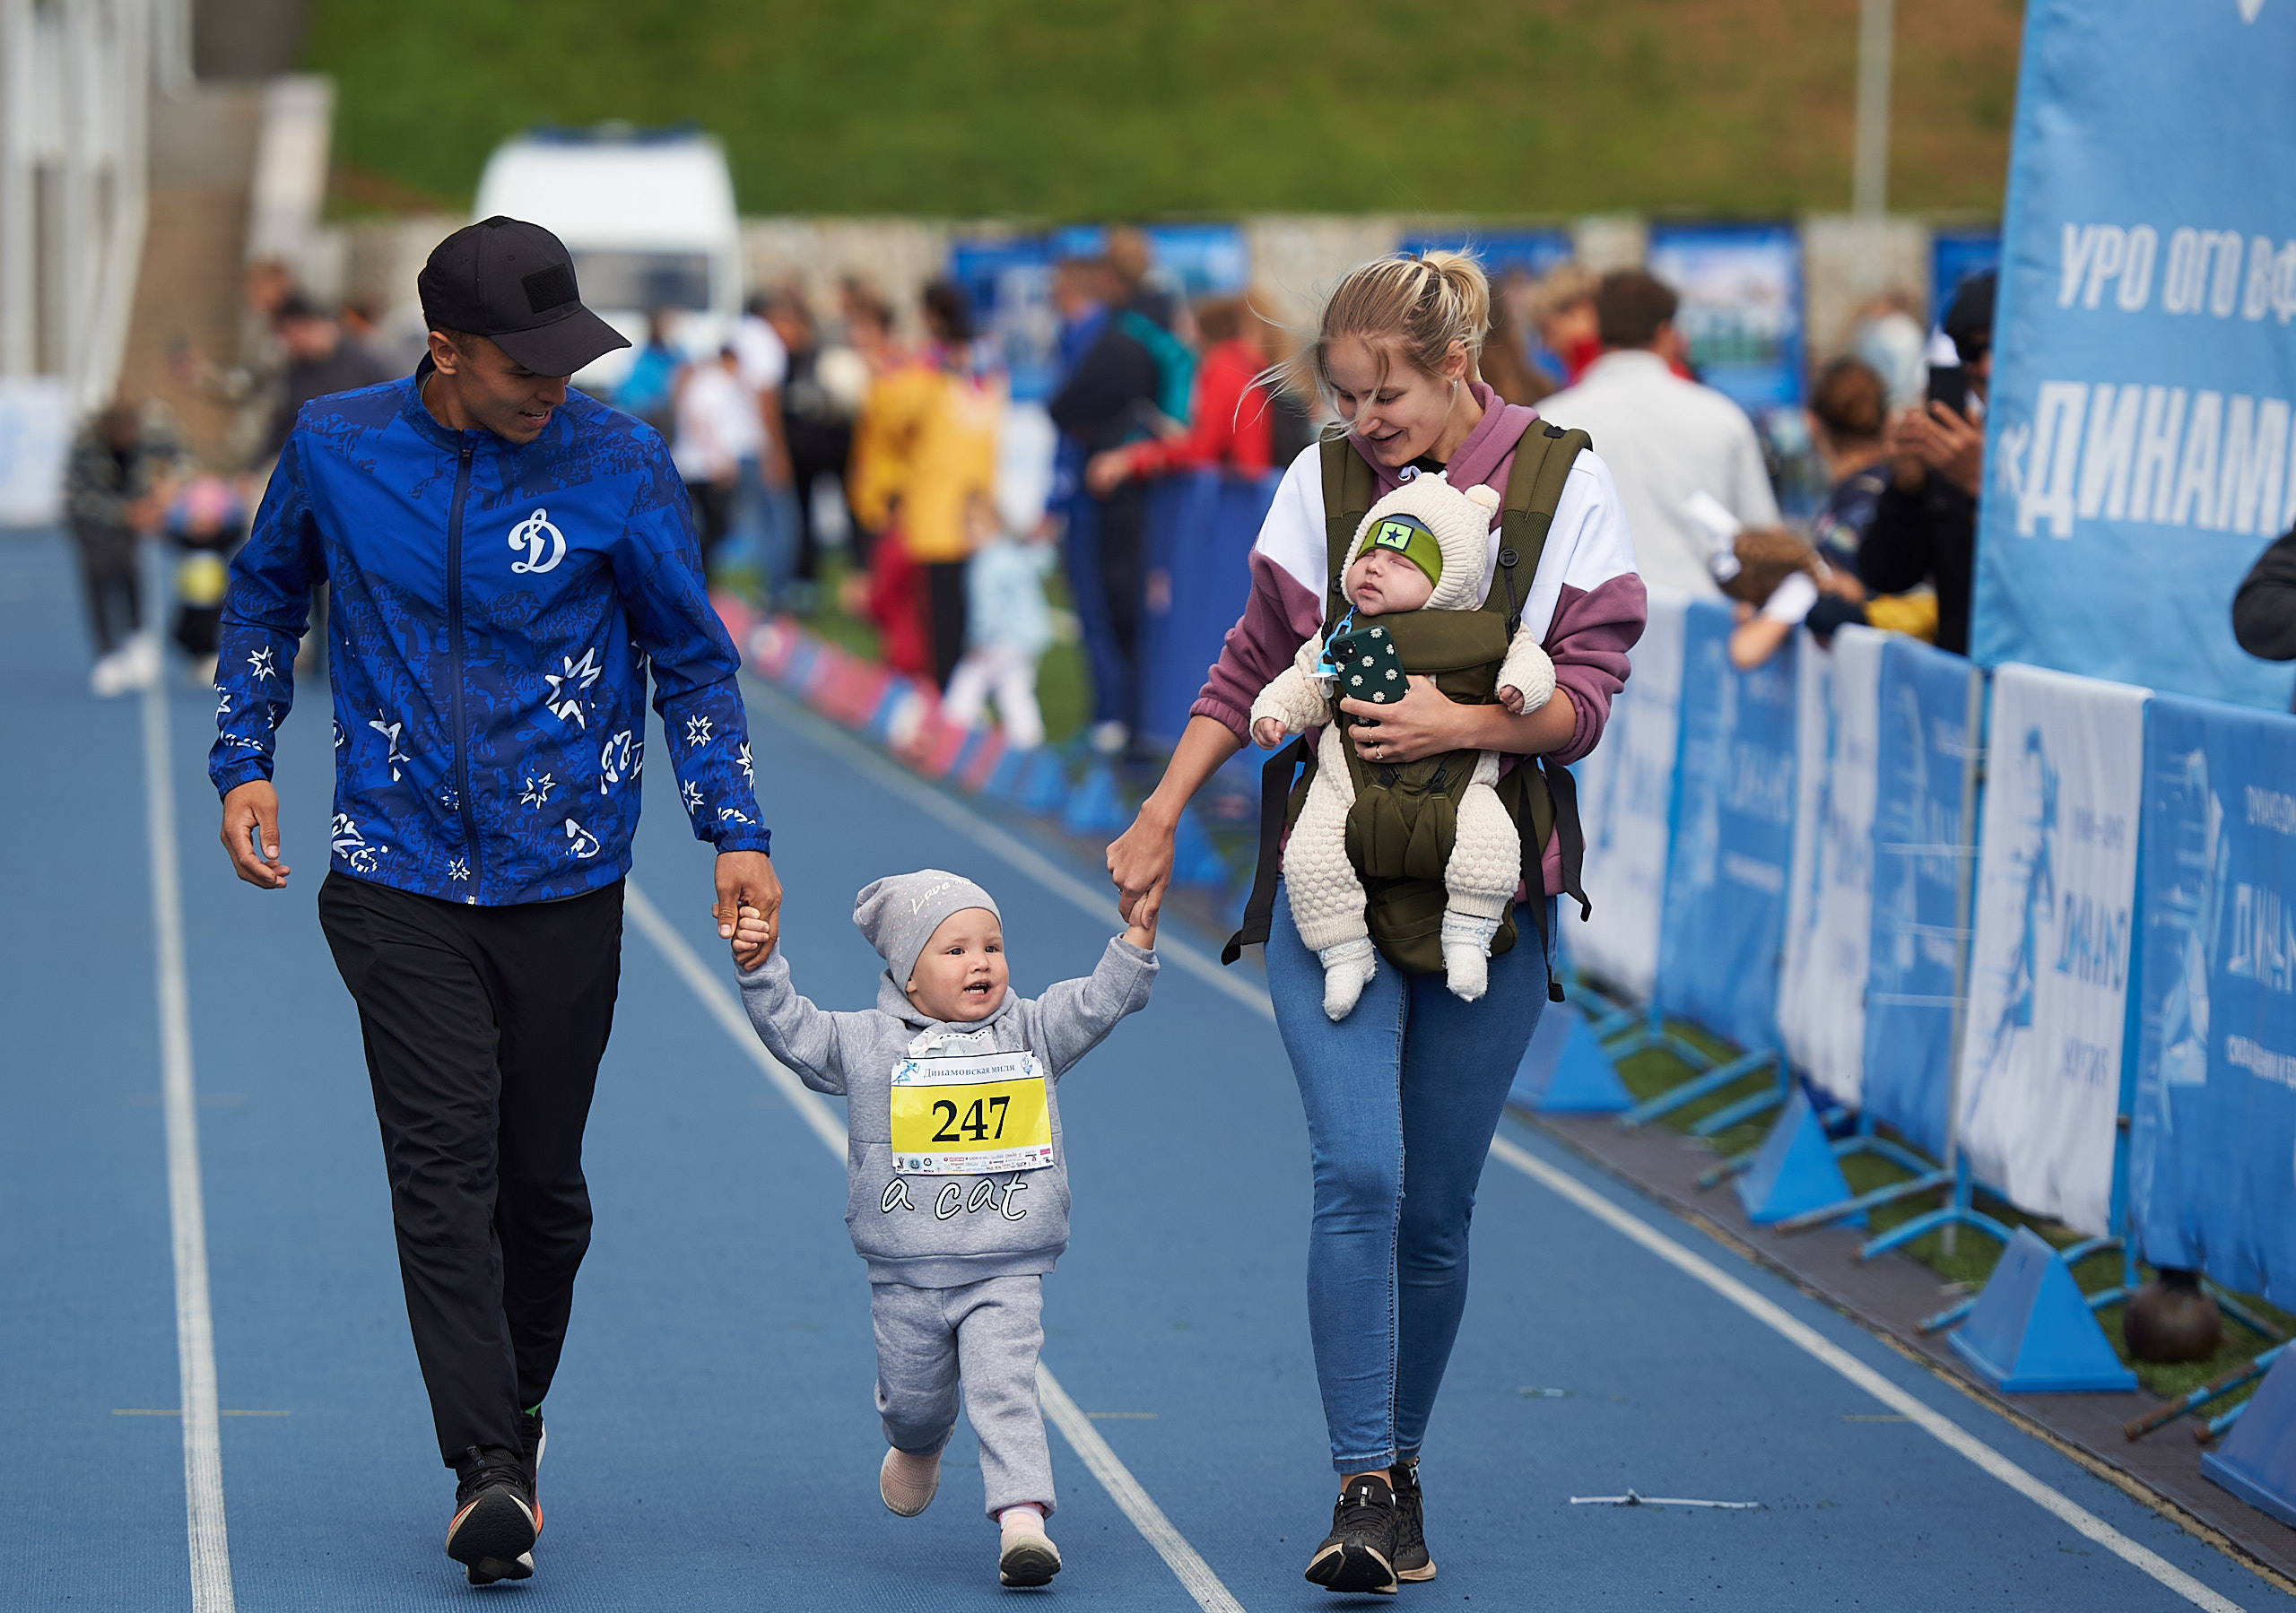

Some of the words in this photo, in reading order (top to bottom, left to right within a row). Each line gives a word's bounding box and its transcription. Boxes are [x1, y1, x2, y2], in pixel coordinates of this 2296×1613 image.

[2057, 221, 2158, 313] УРО
[1995, 379, 2296, 540] «ДИНАМ
[923, 1066, 990, 1079] Динамовская
[991, 1063, 1015, 1074] миля
[931, 1095, 1011, 1143] 247
[880, 1176, 915, 1214] a
[934, 1171, 1029, 1222] cat
